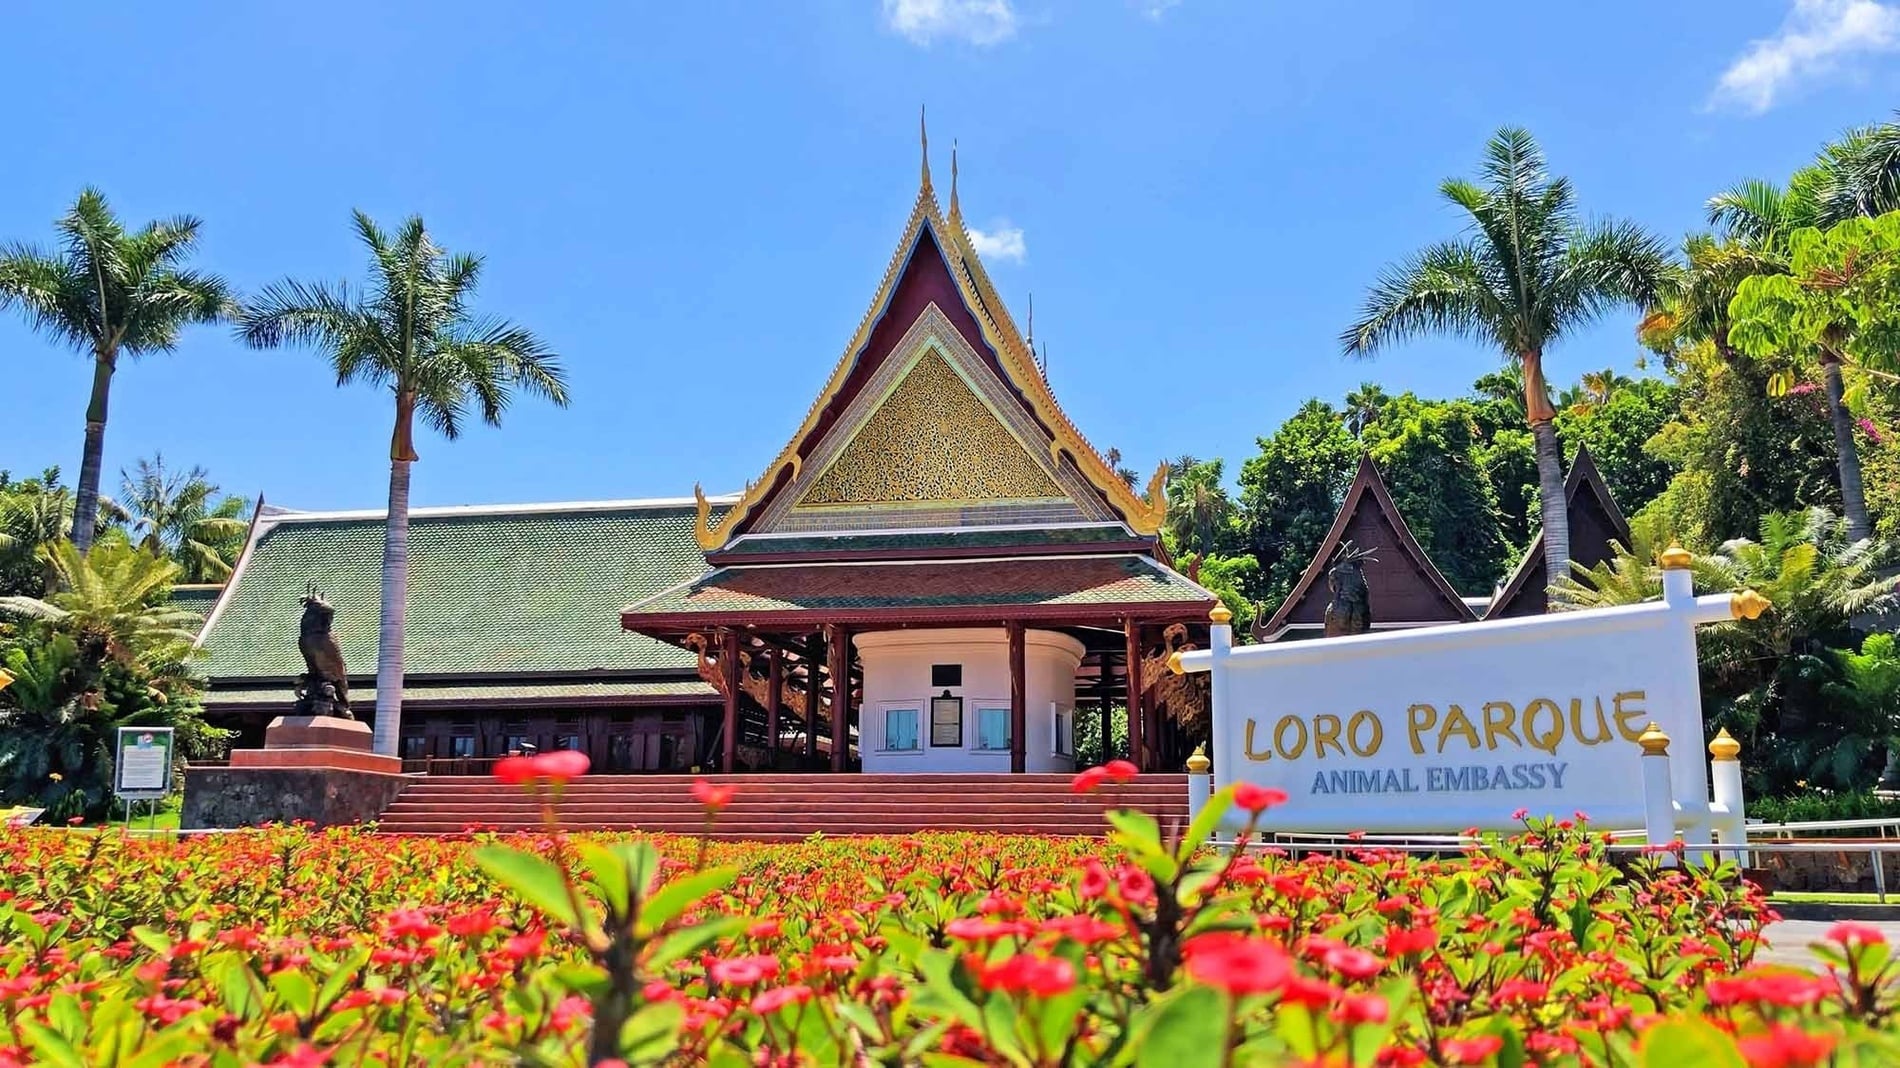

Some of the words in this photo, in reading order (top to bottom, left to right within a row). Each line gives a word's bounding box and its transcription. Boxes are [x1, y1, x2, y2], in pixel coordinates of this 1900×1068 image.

[1244, 711, 1384, 762] LORO
[1407, 690, 1650, 756] PARQUE
[1311, 767, 1420, 795] ANIMAL
[1426, 762, 1568, 791] EMBASSY
